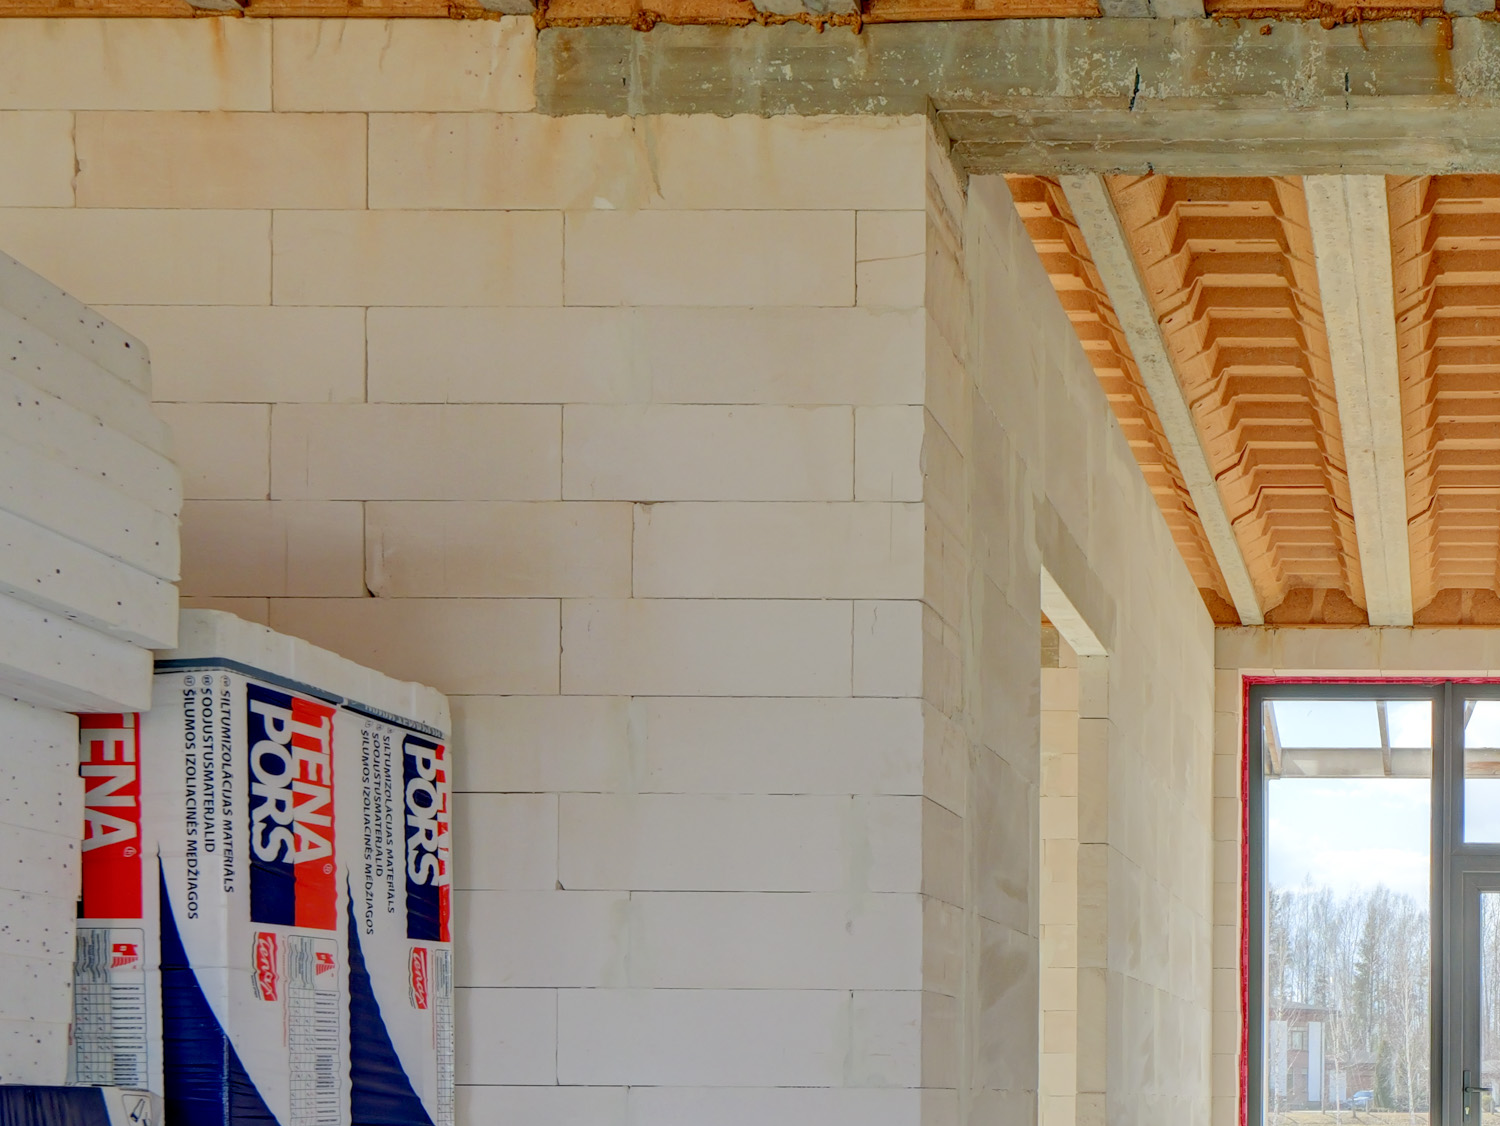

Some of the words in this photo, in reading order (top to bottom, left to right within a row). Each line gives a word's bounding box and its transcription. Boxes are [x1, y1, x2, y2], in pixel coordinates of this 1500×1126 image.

[249, 698, 295, 865] PORS
[291, 715, 333, 864] TENA
[405, 743, 440, 887] PORS
